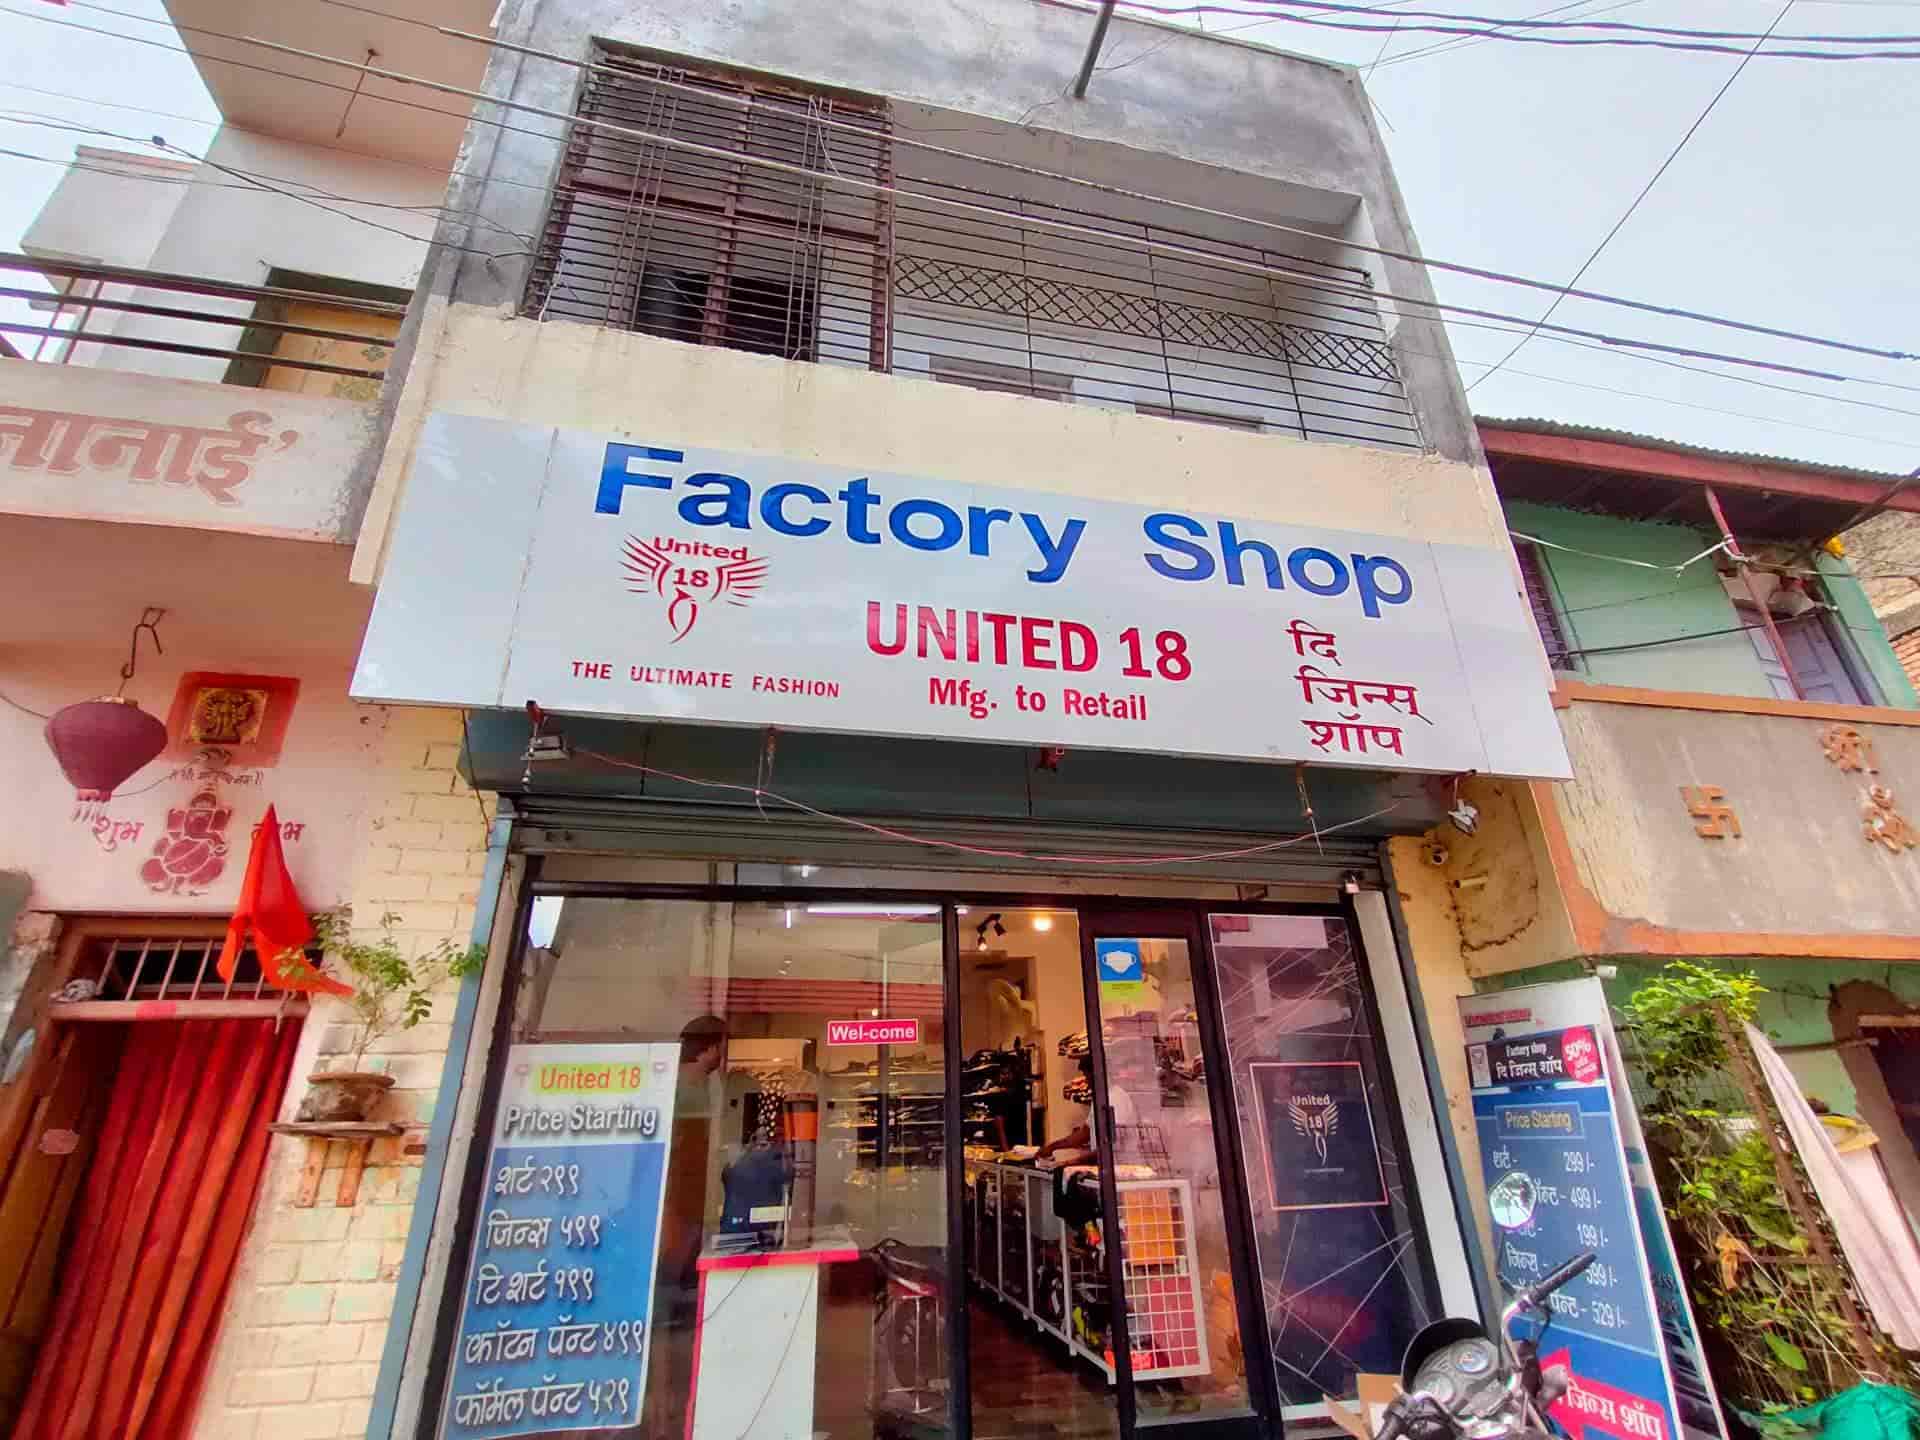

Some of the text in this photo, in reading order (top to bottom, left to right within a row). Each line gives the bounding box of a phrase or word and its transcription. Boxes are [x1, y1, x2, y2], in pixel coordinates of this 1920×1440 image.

[595, 441, 1413, 618] Factory Shop
[653, 536, 748, 562] United
[672, 566, 709, 588] 18
[866, 601, 1192, 681] UNITED 18
[572, 661, 840, 697] THE ULTIMATE FASHION
[929, 677, 1147, 720] Mfg. to Retail
[1301, 711, 1404, 755] शॉप
[831, 1024, 914, 1041] Wel-come
[540, 1066, 641, 1089] United 18
[1291, 1093, 1330, 1106] United
[504, 1104, 657, 1136] Price Starting
[494, 1155, 537, 1195] शर्ट
